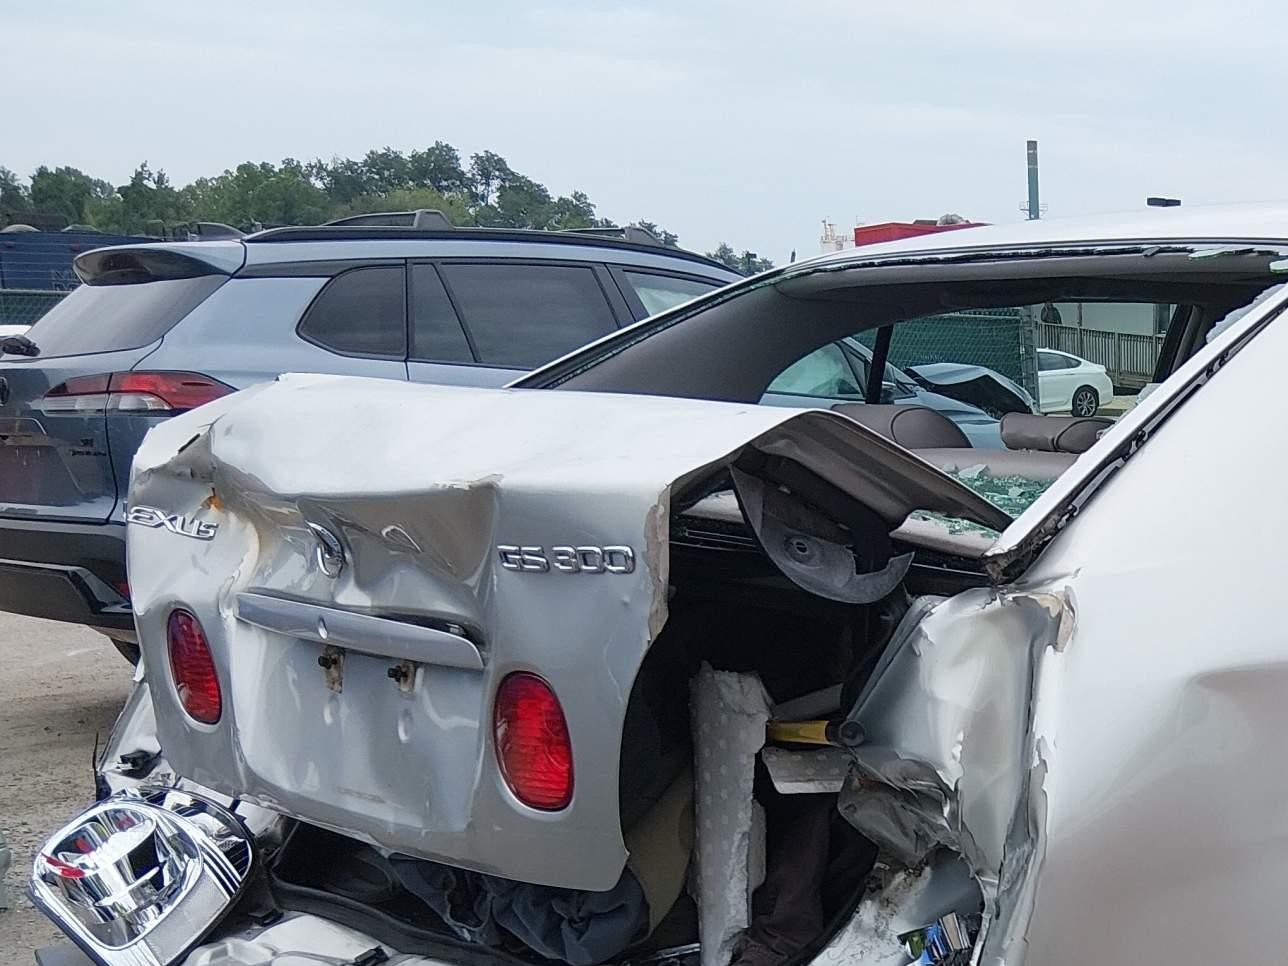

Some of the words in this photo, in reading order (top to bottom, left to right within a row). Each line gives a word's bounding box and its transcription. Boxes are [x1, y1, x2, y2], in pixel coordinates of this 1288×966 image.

[124, 502, 219, 541] EXUS
[497, 544, 550, 574] GS
[554, 545, 637, 574] 300
